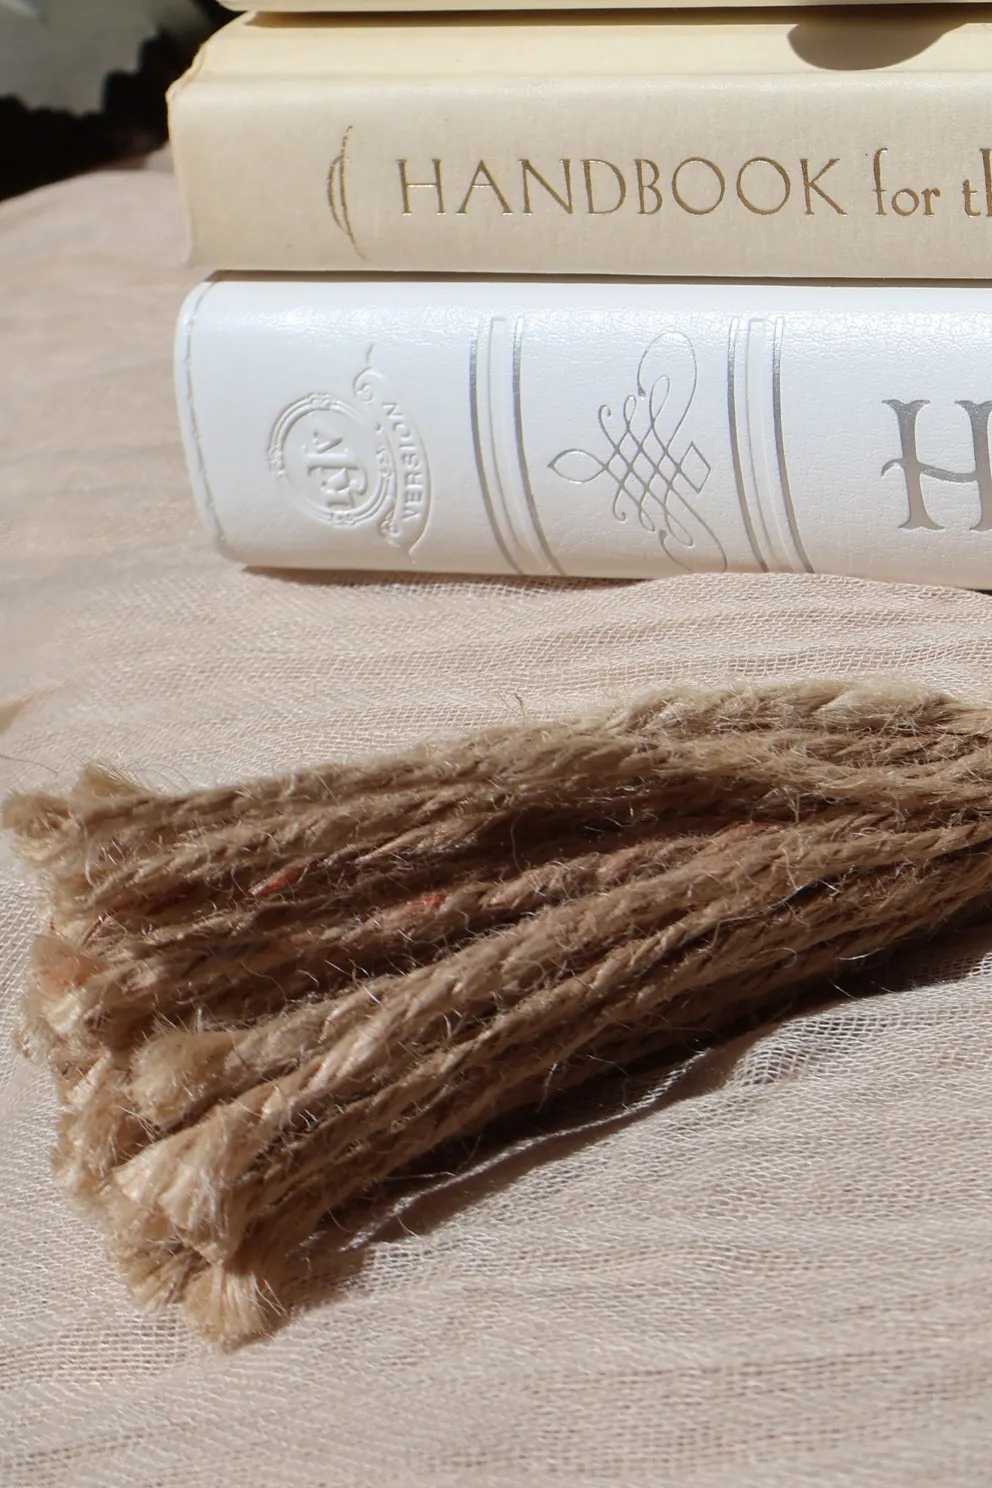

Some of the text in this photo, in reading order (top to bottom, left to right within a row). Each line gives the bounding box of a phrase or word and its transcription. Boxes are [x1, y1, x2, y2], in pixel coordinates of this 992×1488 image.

[396, 156, 848, 216] HANDBOOK
[872, 146, 941, 218] for
[381, 402, 424, 522] VERSION
